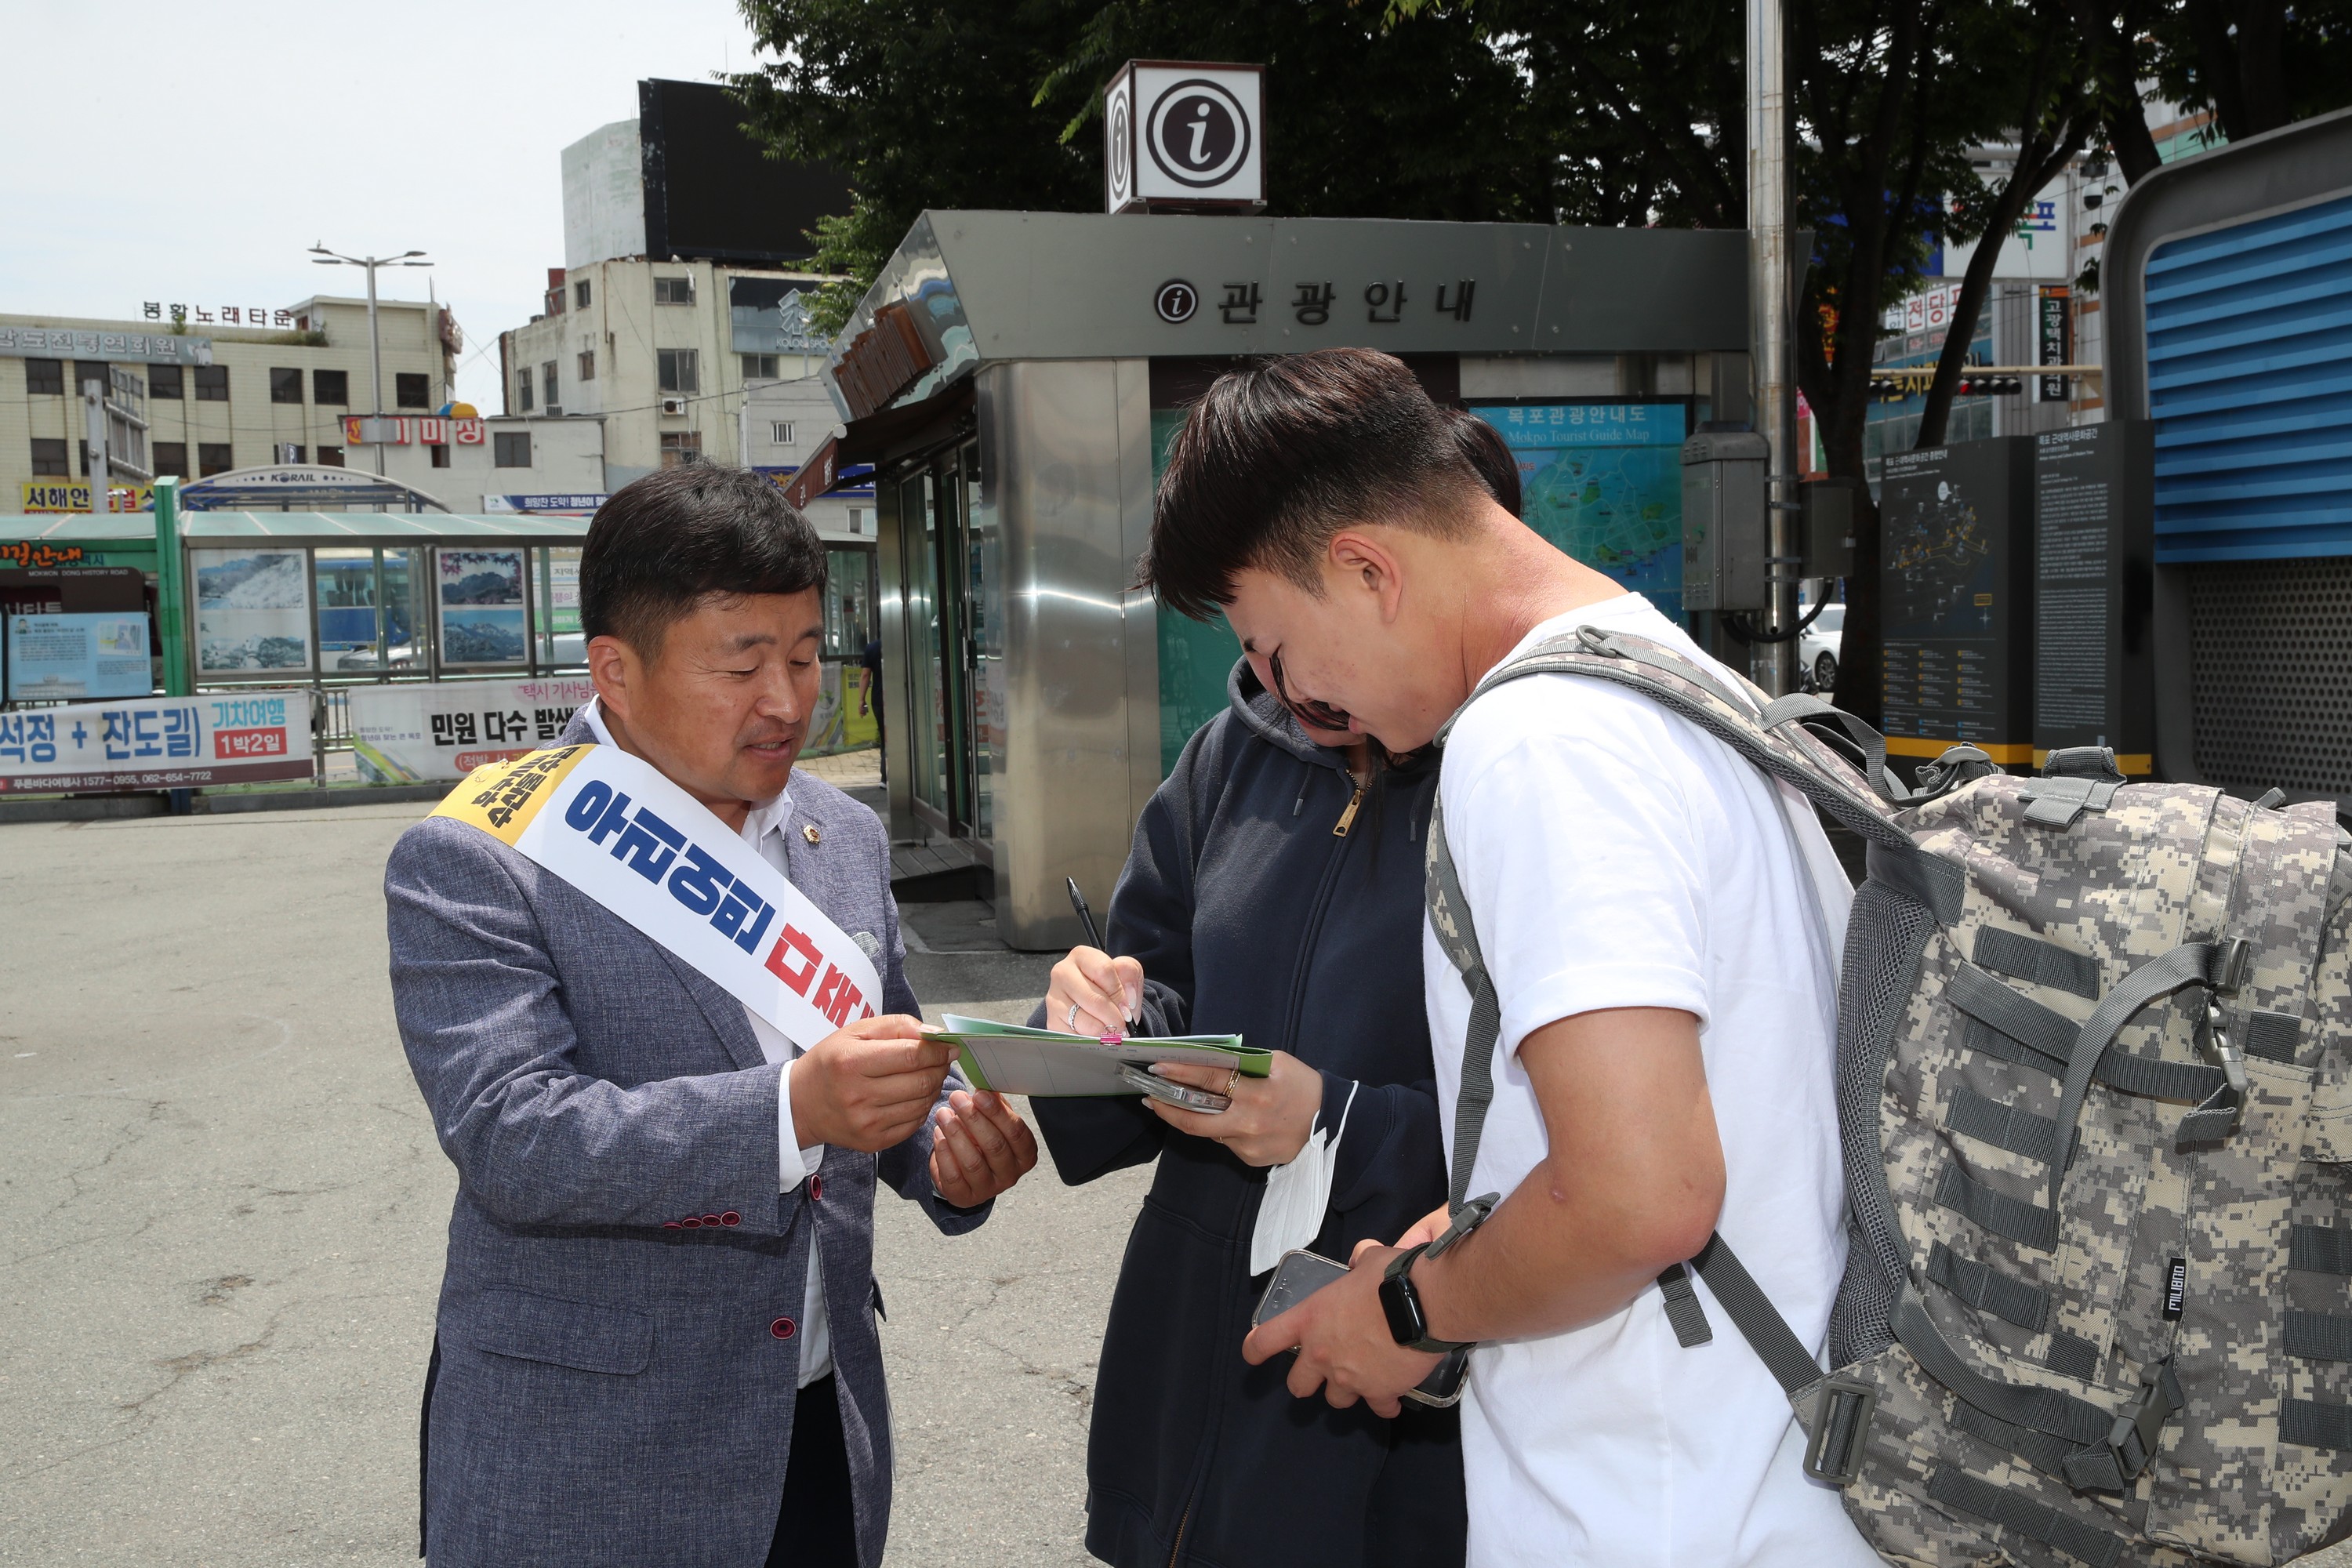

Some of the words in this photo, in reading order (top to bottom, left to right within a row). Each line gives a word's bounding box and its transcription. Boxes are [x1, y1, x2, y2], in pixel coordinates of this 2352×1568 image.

[143, 301, 293, 326] 봉황노래타운
[1218, 278, 1477, 326] 관광안내
[1508, 406, 1646, 426] 목포관광안내도
[1510, 431, 1547, 446] Mokpo
[1549, 430, 1587, 442] Tourist
[1589, 429, 1623, 441] Guide
[1625, 429, 1650, 444] Map
[270, 472, 316, 483] KORAIL
[27, 487, 90, 508] 서해안
[211, 698, 286, 728] 기차여행
[0, 714, 56, 764] 석정
[102, 706, 201, 761] 잔도길)
[431, 712, 477, 746] 민원
[483, 710, 528, 742] 다수
[221, 733, 281, 755] 1박2일
[142, 771, 212, 784] 062-654-7722
[487, 772, 548, 829] 수산물
[537, 746, 582, 774] 수입
[564, 779, 776, 956] 우리어민
